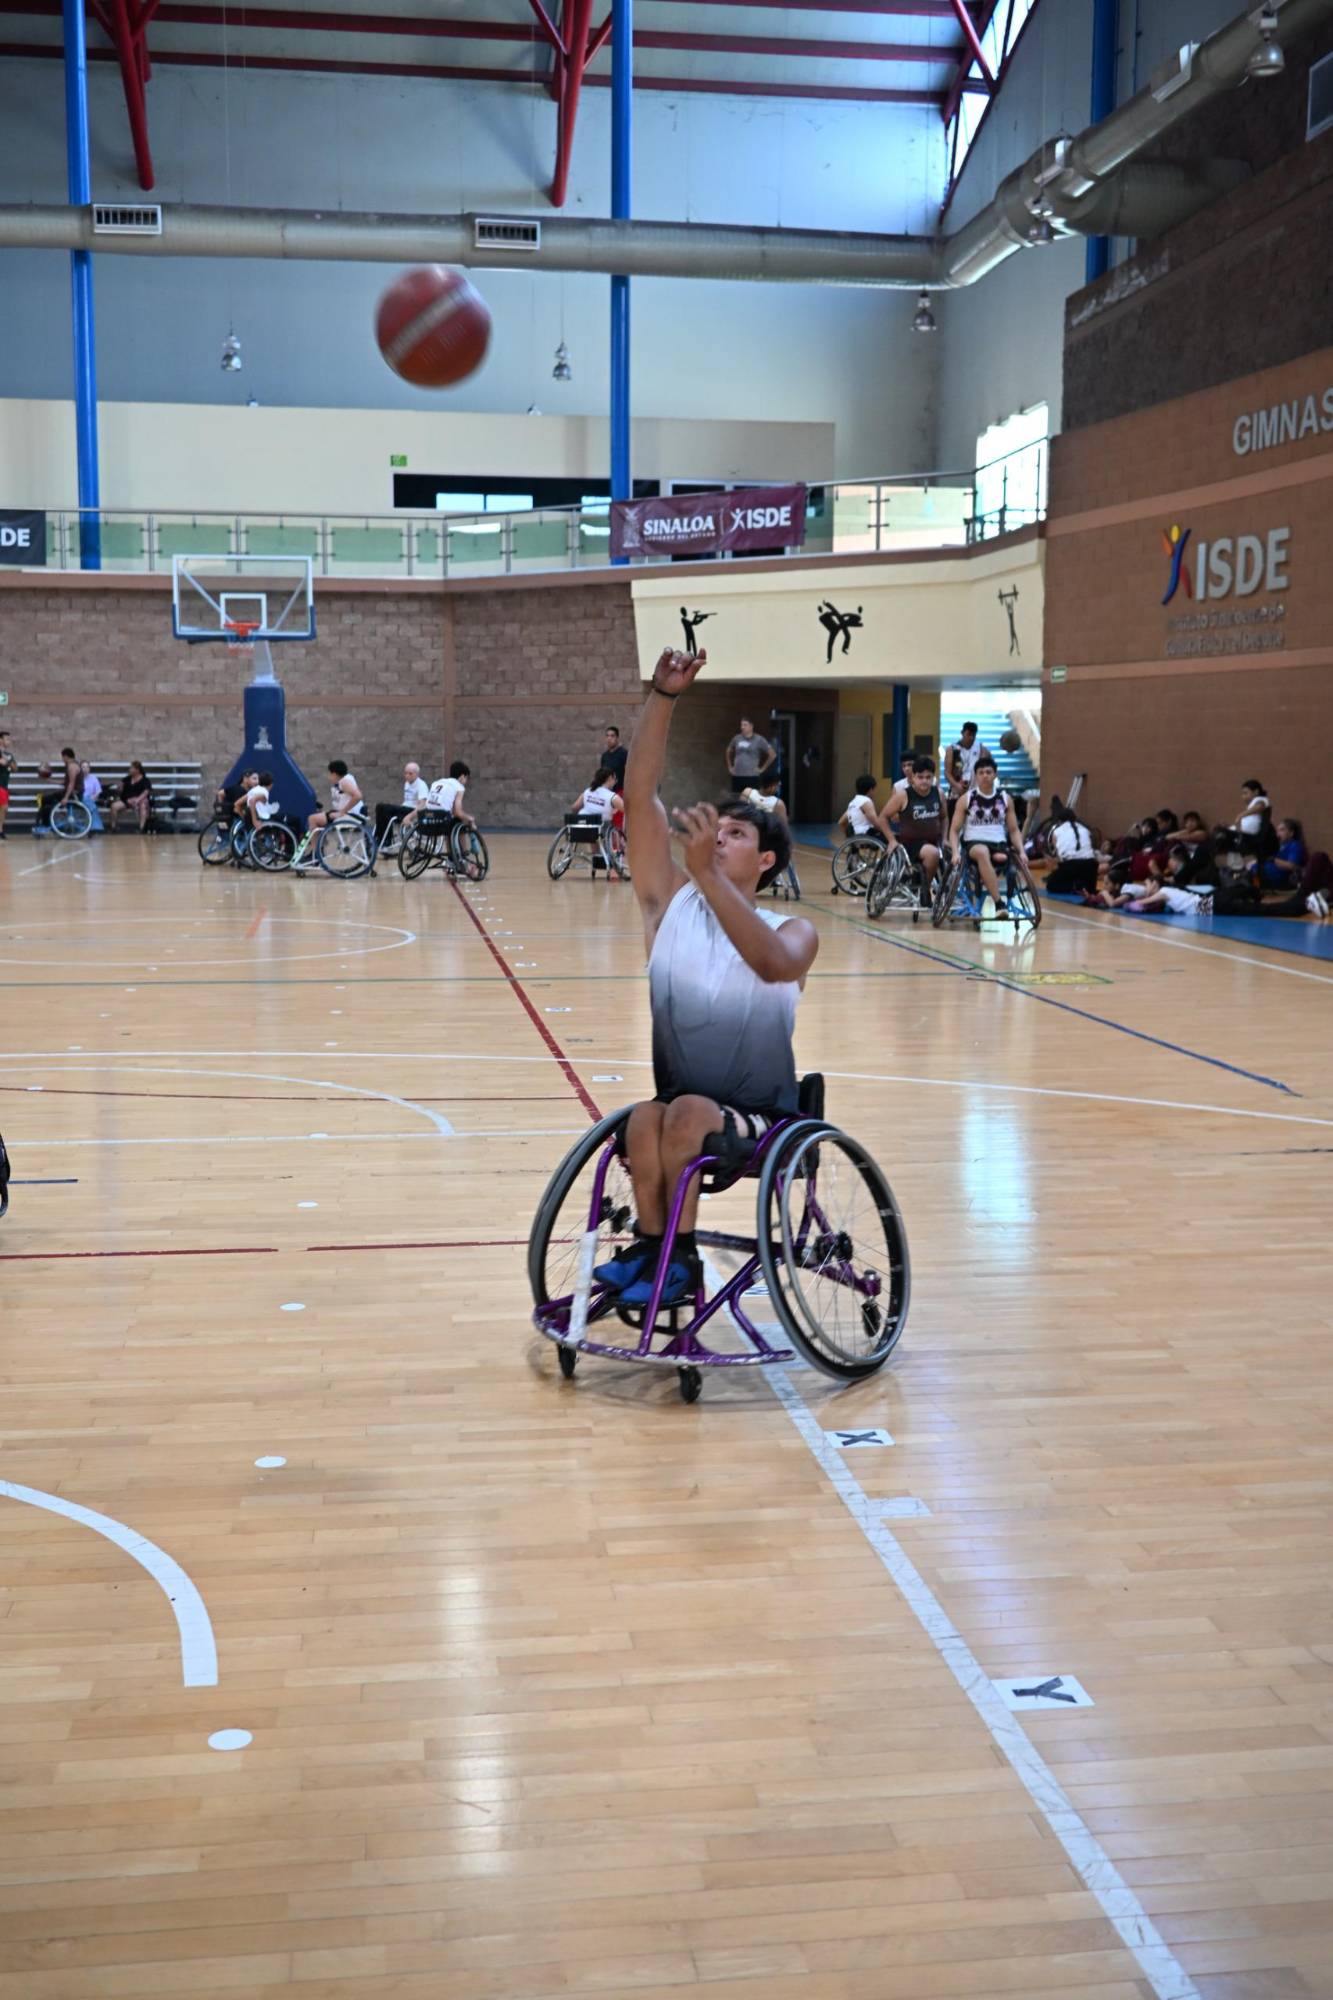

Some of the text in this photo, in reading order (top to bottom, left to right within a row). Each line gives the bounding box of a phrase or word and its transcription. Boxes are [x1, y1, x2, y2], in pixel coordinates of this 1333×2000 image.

[1233, 387, 1333, 456] GIMNAS
[643, 515, 715, 535] SINALOA
[0, 527, 31, 547] DE
[1196, 527, 1290, 600] ISDE
[835, 1431, 884, 1447] X
[1012, 1676, 1078, 1703] Y
